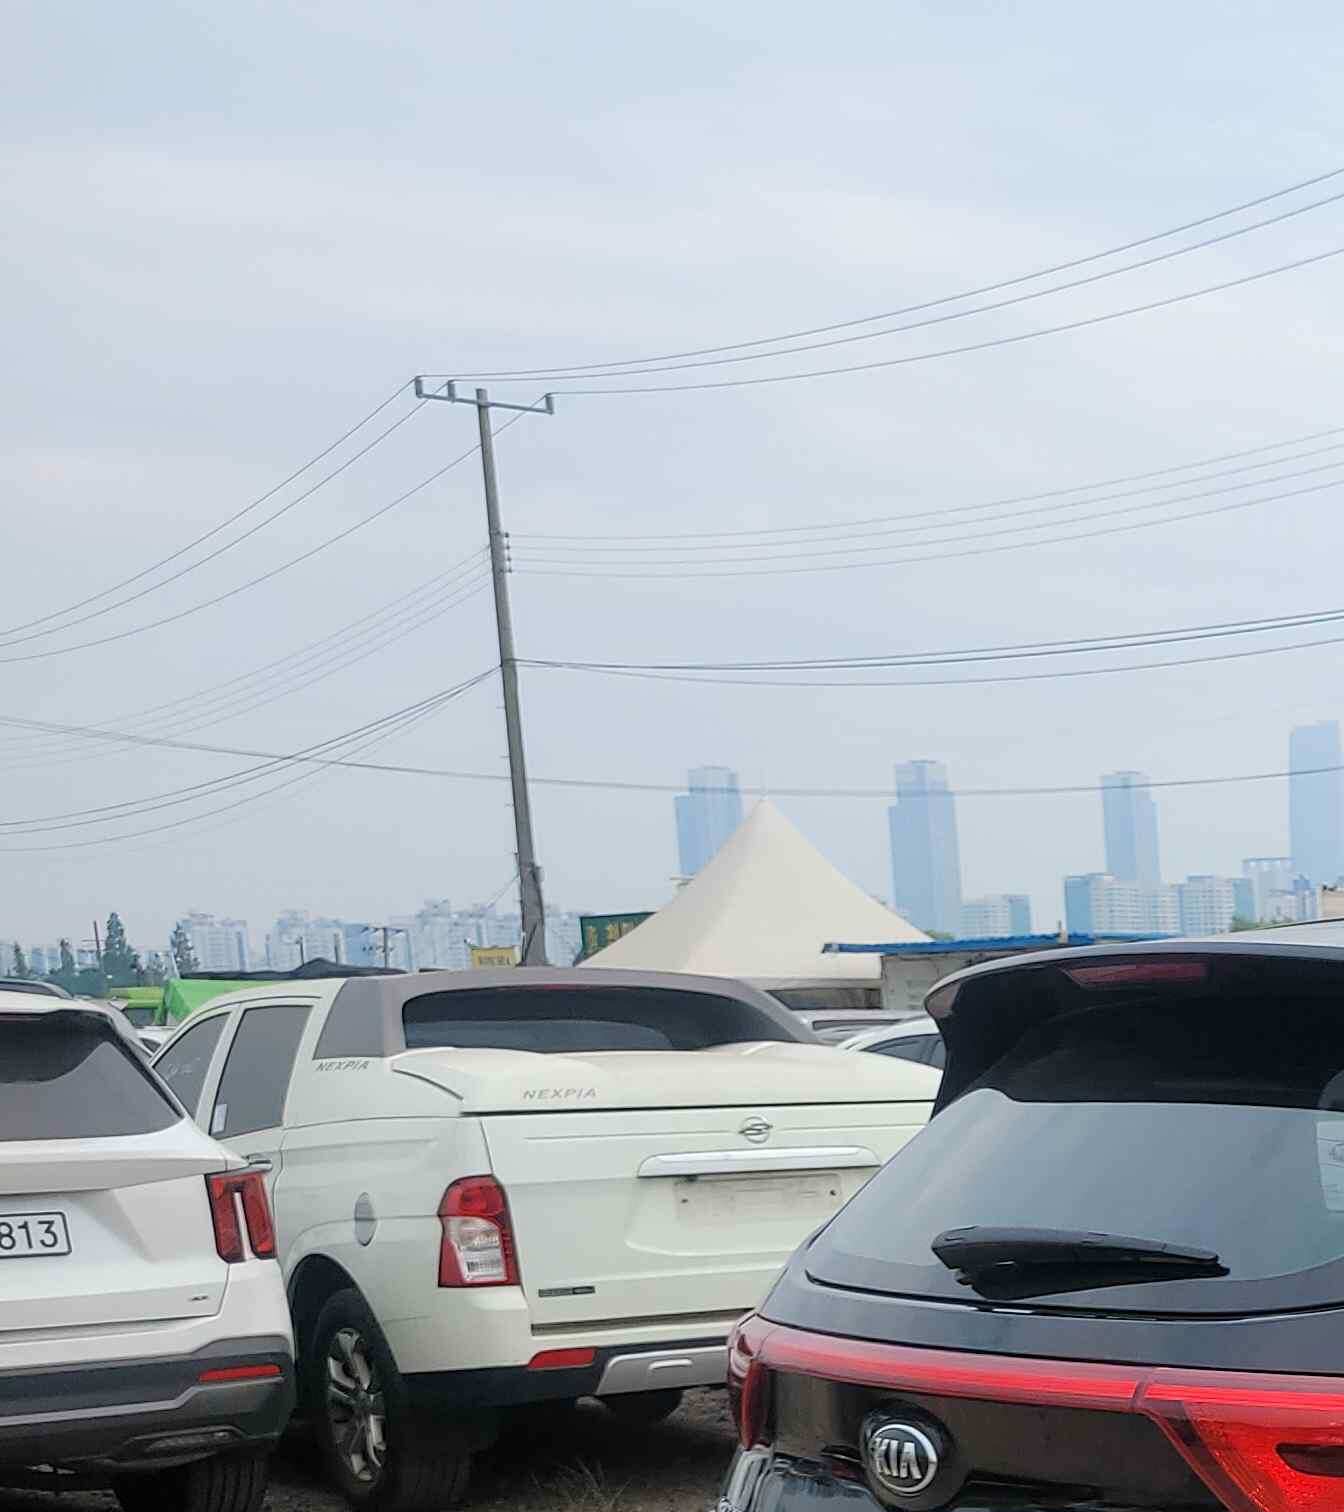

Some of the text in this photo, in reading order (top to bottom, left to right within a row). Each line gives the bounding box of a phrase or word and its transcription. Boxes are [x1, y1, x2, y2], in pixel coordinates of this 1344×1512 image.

[315, 1059, 370, 1073] NEXPIA
[521, 1086, 598, 1101] NEXPIA
[872, 1436, 923, 1480] KIA
